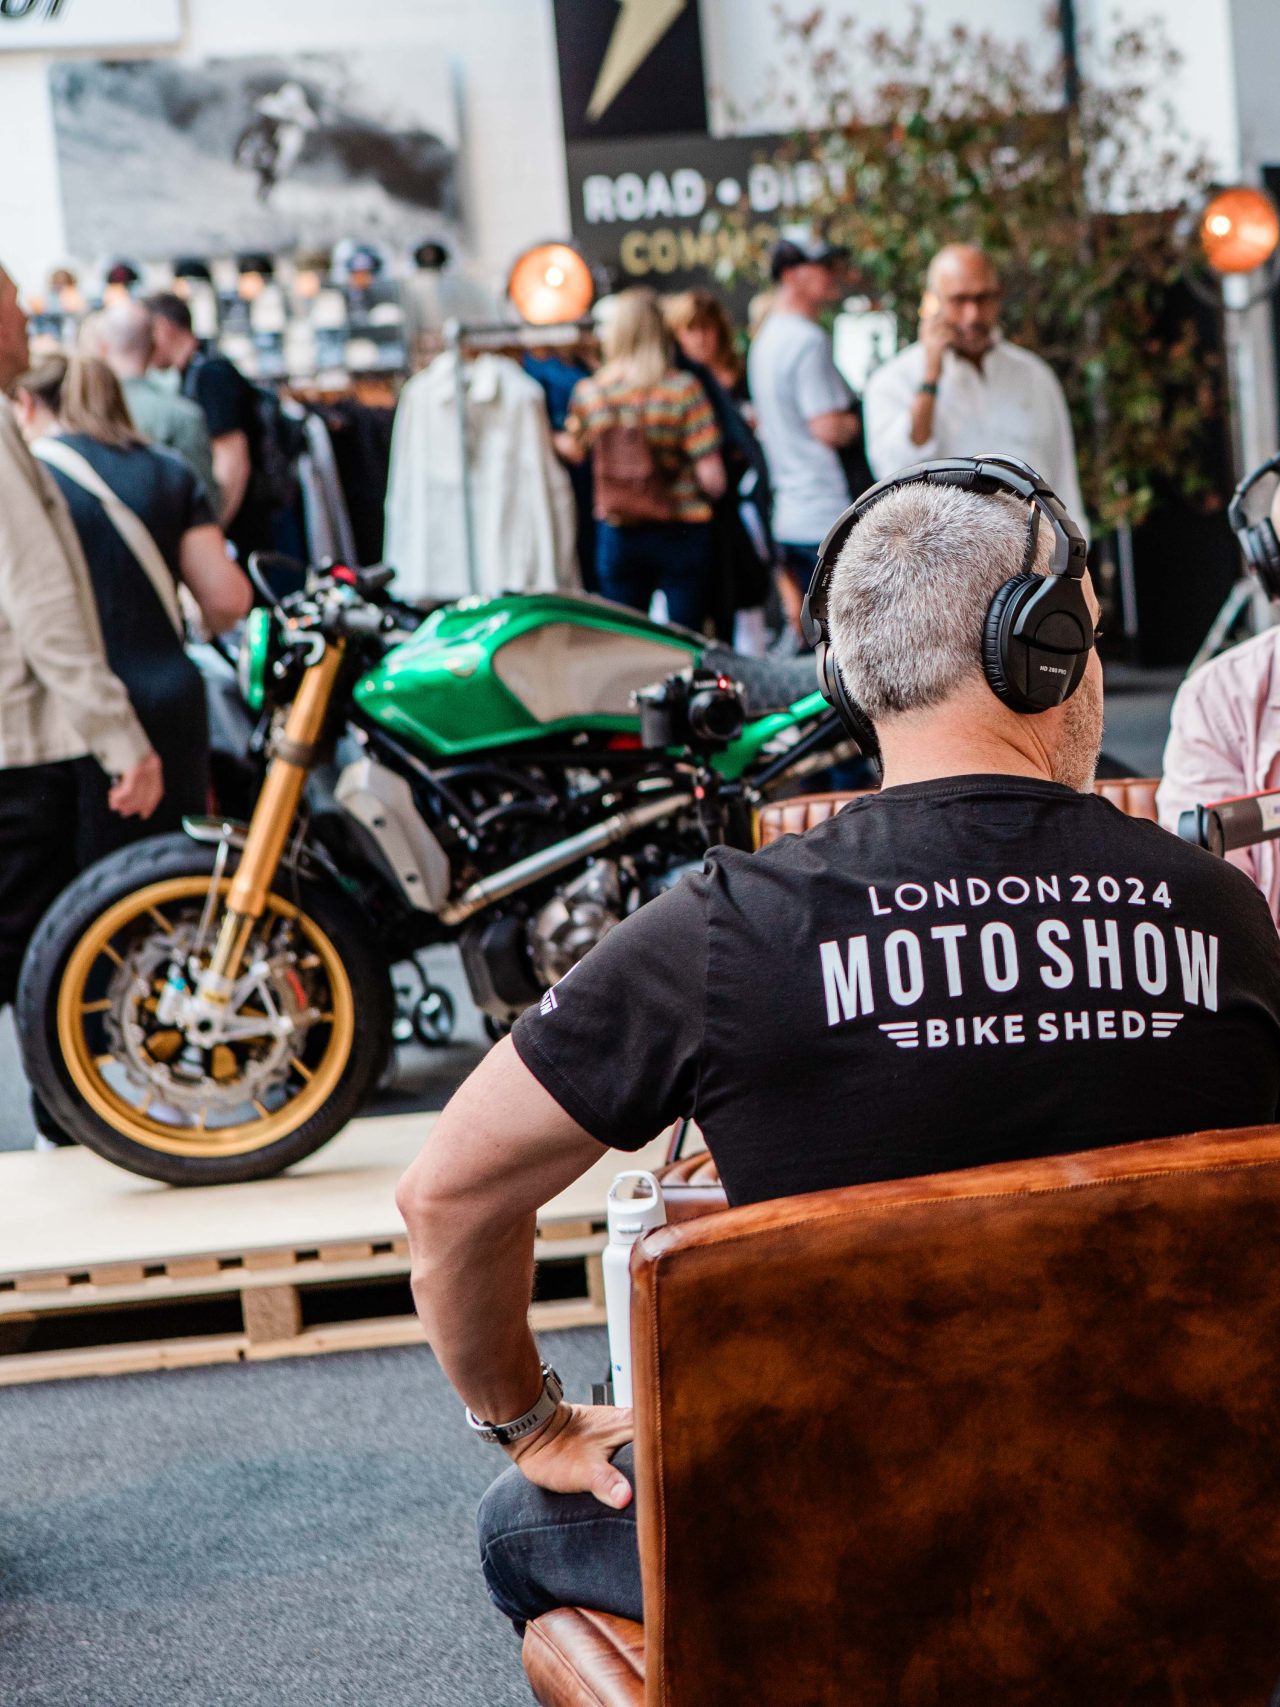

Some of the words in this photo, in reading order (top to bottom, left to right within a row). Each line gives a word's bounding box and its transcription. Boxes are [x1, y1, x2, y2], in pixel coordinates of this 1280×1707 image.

[582, 168, 706, 223] ROAD
[868, 875, 1061, 916] LONDON
[1069, 875, 1173, 909] 2024
[926, 1014, 1026, 1048] BIKE
[1037, 1010, 1146, 1043] SHED
